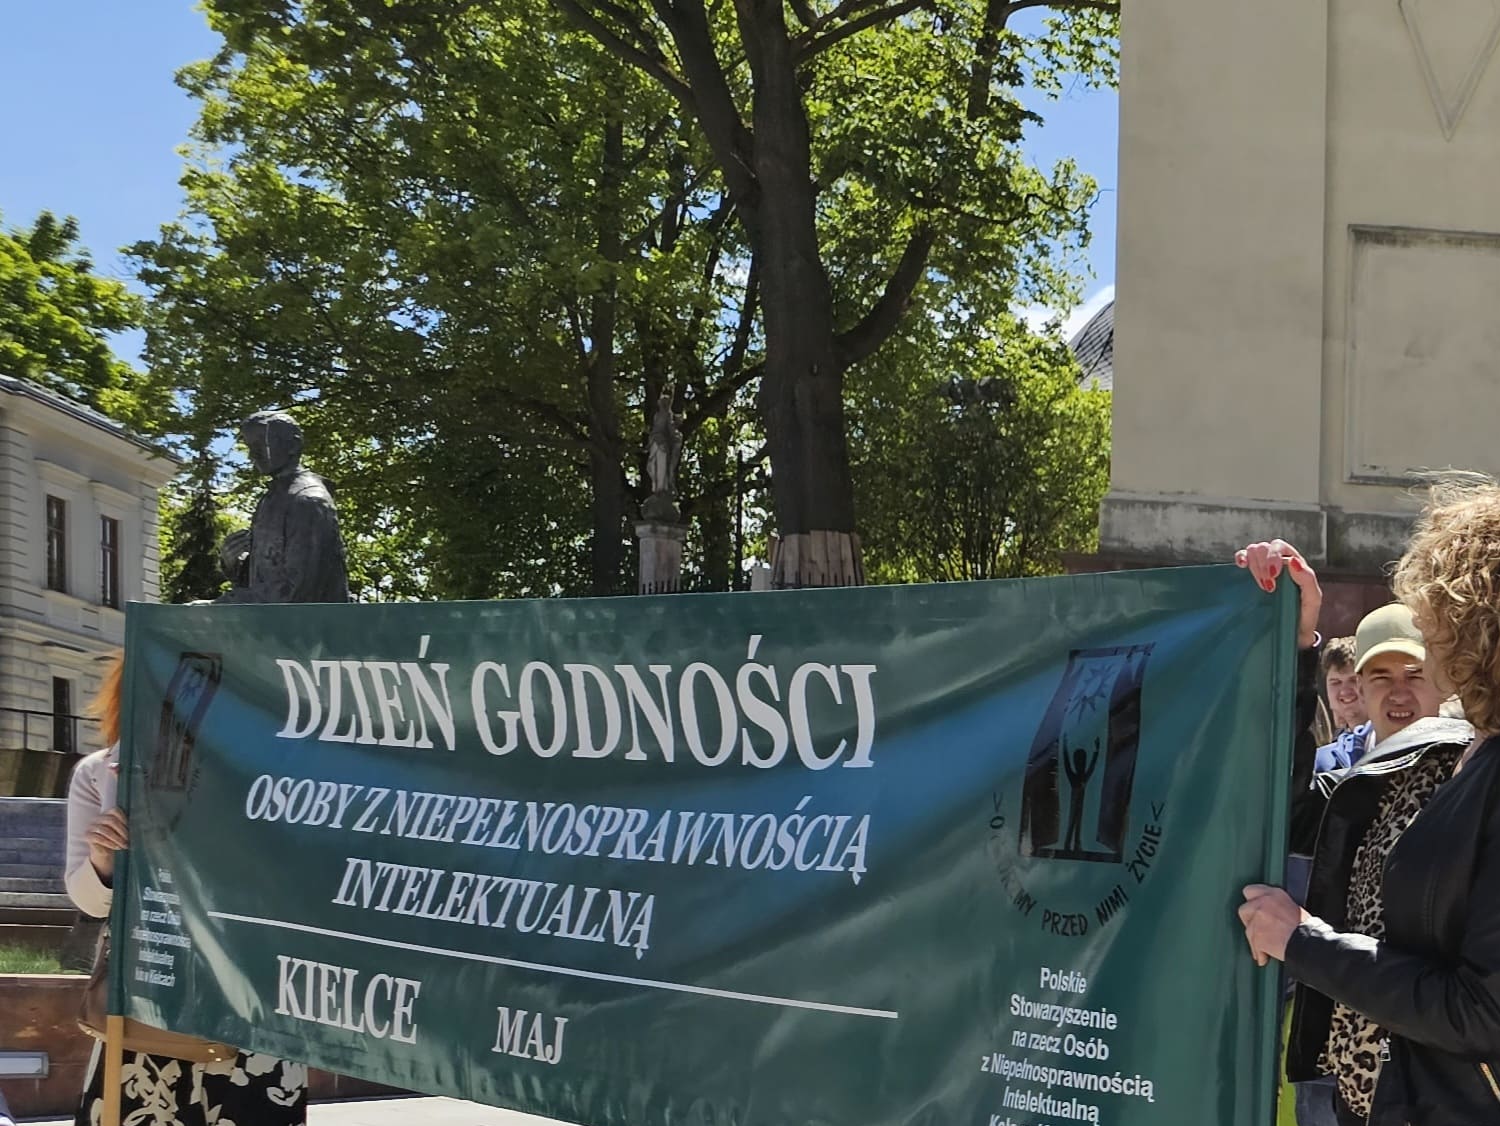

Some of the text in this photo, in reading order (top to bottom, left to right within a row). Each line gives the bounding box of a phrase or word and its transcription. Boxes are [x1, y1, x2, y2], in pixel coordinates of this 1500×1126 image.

[275, 635, 877, 770] DZIEŃ GODNOŚCI
[245, 774, 871, 886] OSOBY Z NIEPEŁNOSPRAWNOŚCIĄ
[1041, 824, 1163, 937] PRZED NIMI ŻYCIE
[332, 857, 655, 960] INTELEKTUALNĄ
[274, 955, 569, 1066] KIELCE MAJ
[1010, 993, 1118, 1030] Stowarzyszenie
[1040, 967, 1087, 994] Polskie
[980, 1052, 1155, 1103] z Niepełnosprawnością
[1011, 1030, 1110, 1061] na rzecz Osób
